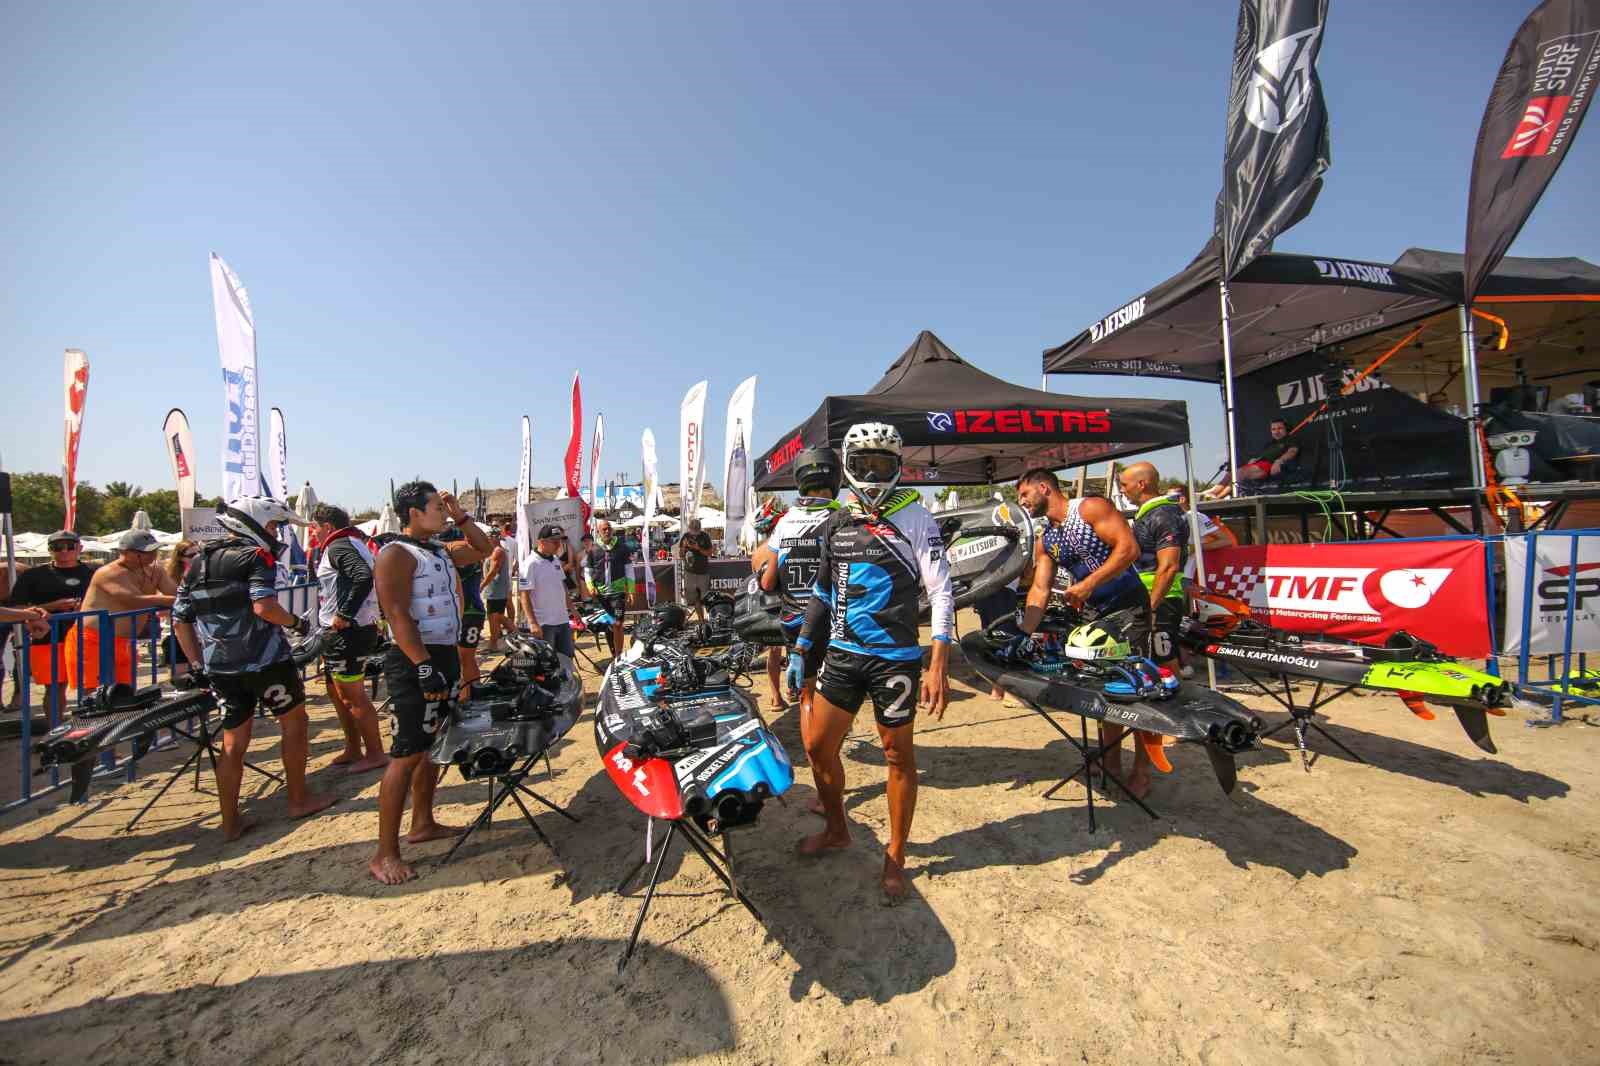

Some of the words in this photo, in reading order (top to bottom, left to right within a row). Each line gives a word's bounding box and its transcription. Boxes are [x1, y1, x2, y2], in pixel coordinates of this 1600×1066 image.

[1534, 44, 1562, 92] MOTO
[1547, 42, 1582, 91] SURF
[1547, 117, 1573, 155] WORLD
[1104, 297, 1146, 336] JETSURF
[955, 409, 1113, 433] IZELTAS
[968, 539, 999, 557] JETSURF
[788, 565, 820, 590] 17
[838, 562, 848, 600] RACING
[1268, 576, 1358, 601] TMF
[836, 601, 847, 639] OCKET
[1276, 609, 1328, 621] Motorcycling
[1331, 613, 1381, 623] Federation
[466, 627, 479, 644] 8
[1153, 632, 1171, 657] 6
[1247, 650, 1319, 669] KAPTANOĞLU
[264, 684, 293, 709] 3
[884, 675, 912, 718] 2
[422, 702, 440, 734] 5
[1121, 711, 1139, 721] DFI
[697, 760, 726, 781] ROCKET
